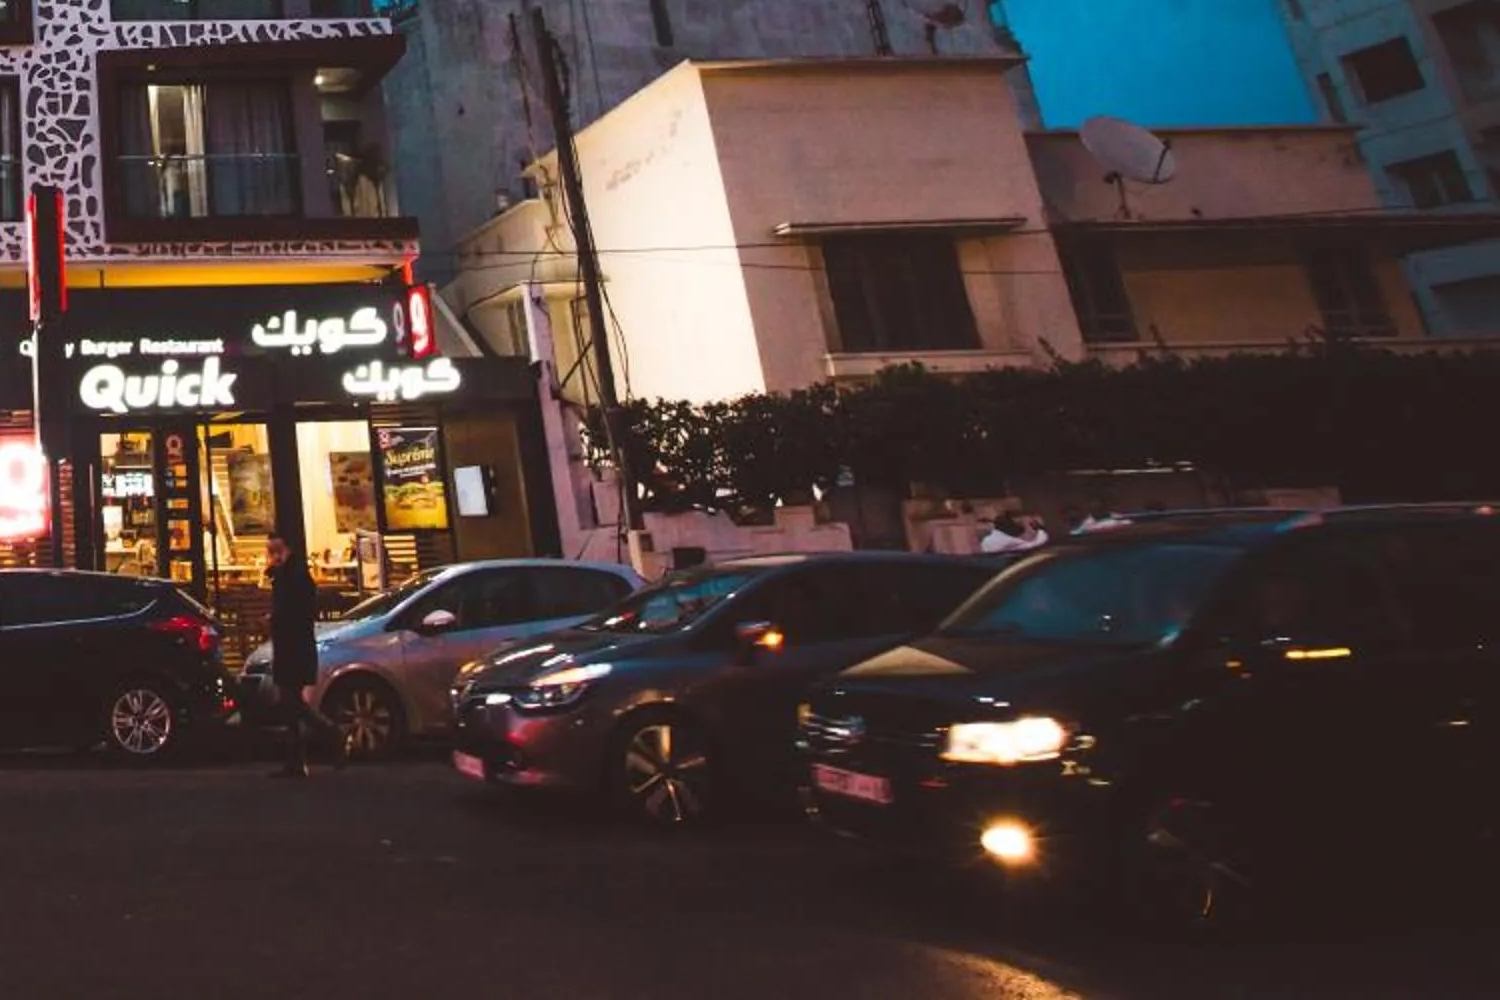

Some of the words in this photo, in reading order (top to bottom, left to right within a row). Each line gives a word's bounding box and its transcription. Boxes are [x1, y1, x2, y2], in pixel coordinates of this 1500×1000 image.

[80, 338, 134, 358] Burger
[139, 337, 225, 354] Restaurant
[252, 306, 387, 356] كويك
[79, 355, 238, 414] Quick
[341, 356, 462, 401] كويك
